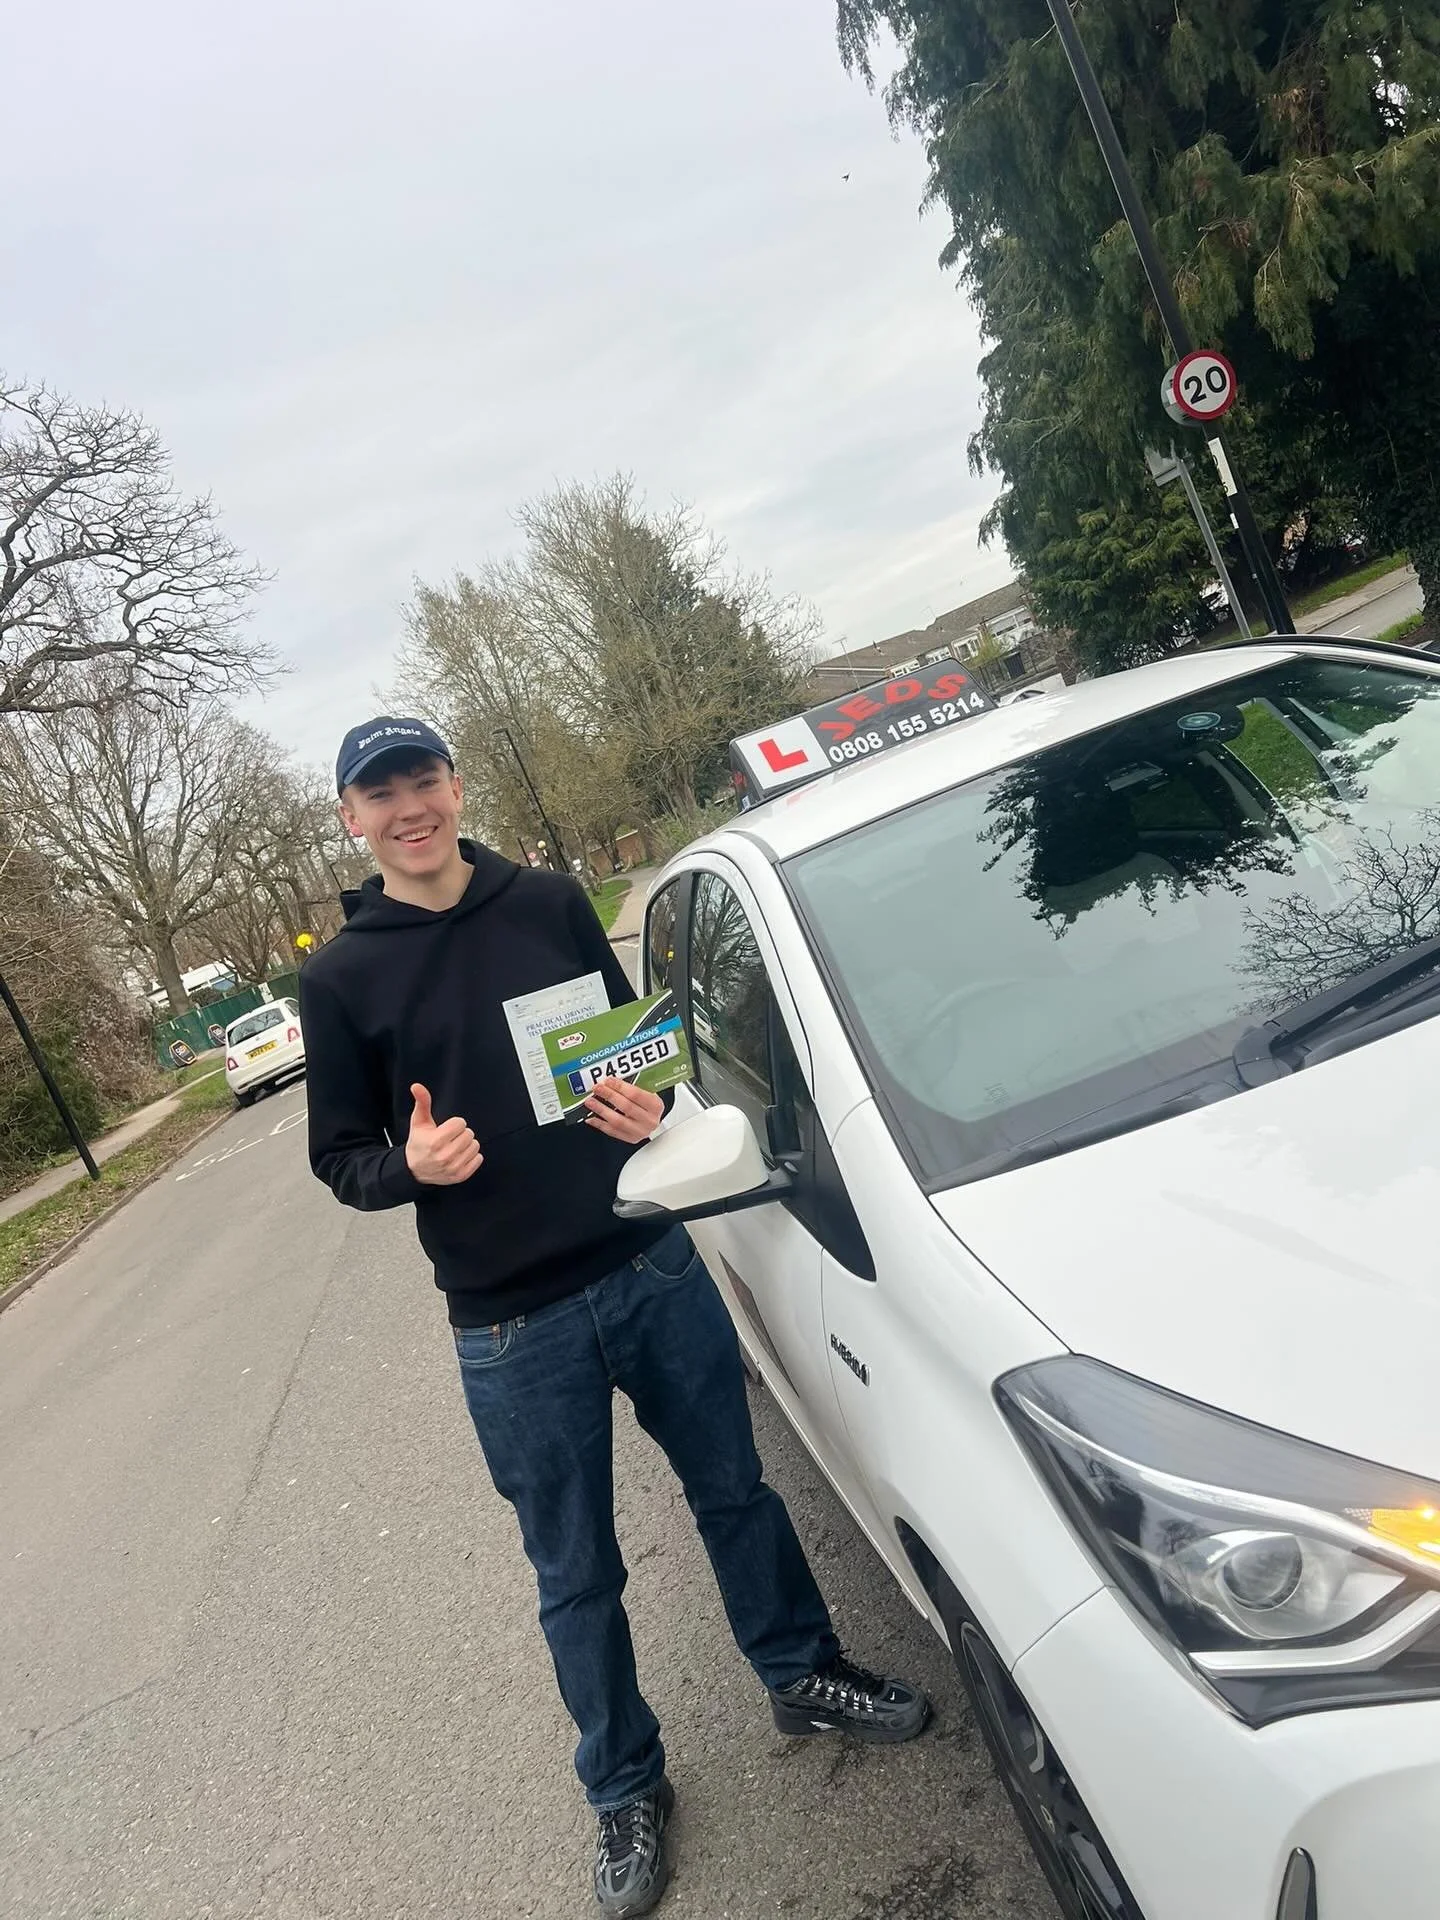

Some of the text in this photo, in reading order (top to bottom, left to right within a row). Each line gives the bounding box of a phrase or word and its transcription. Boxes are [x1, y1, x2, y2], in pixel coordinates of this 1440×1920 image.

[1183, 366, 1227, 405] 20
[816, 672, 967, 741] JEDS
[829, 691, 986, 763] 0808 155 5214
[757, 738, 809, 773] L
[580, 1025, 660, 1065] CONGRATULATIONS
